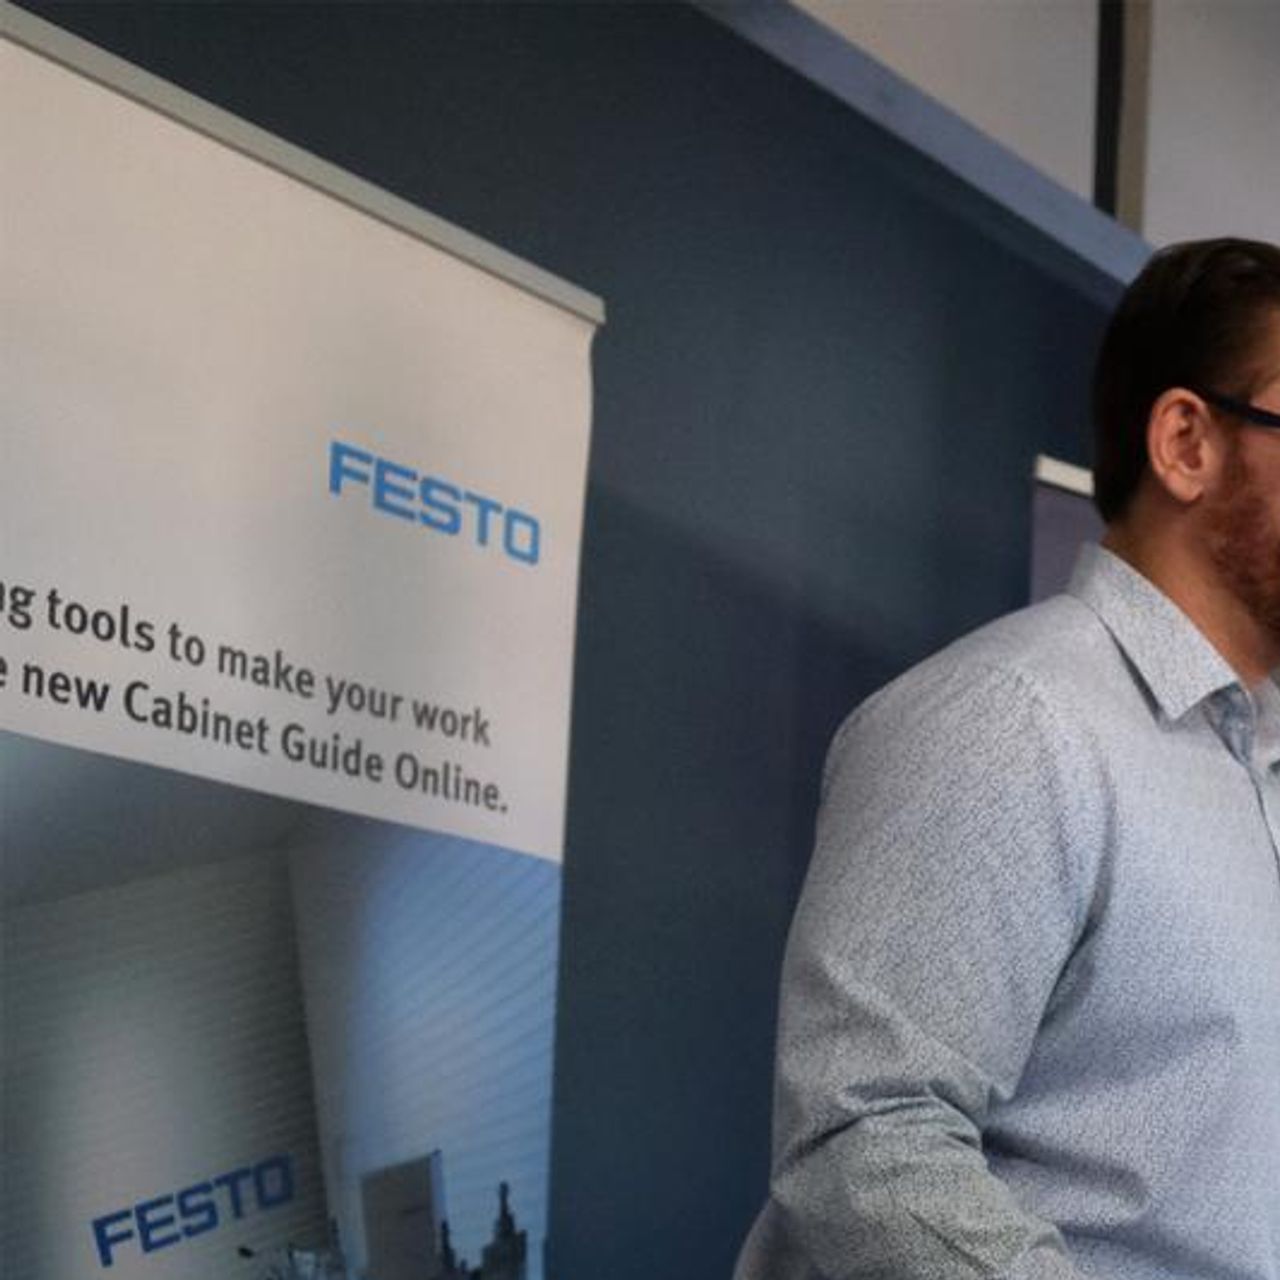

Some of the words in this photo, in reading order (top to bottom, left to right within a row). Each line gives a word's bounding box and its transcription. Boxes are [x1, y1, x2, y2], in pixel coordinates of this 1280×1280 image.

[329, 440, 541, 566] FESTO
[48, 588, 156, 653] tools
[168, 623, 205, 667] to
[218, 650, 315, 699] make
[325, 674, 404, 723] your
[412, 700, 491, 747] work
[22, 662, 110, 713] new
[123, 681, 270, 754] Cabinet
[281, 723, 384, 783] Guide
[395, 752, 508, 814] Online.
[91, 1154, 295, 1268] FESTO
